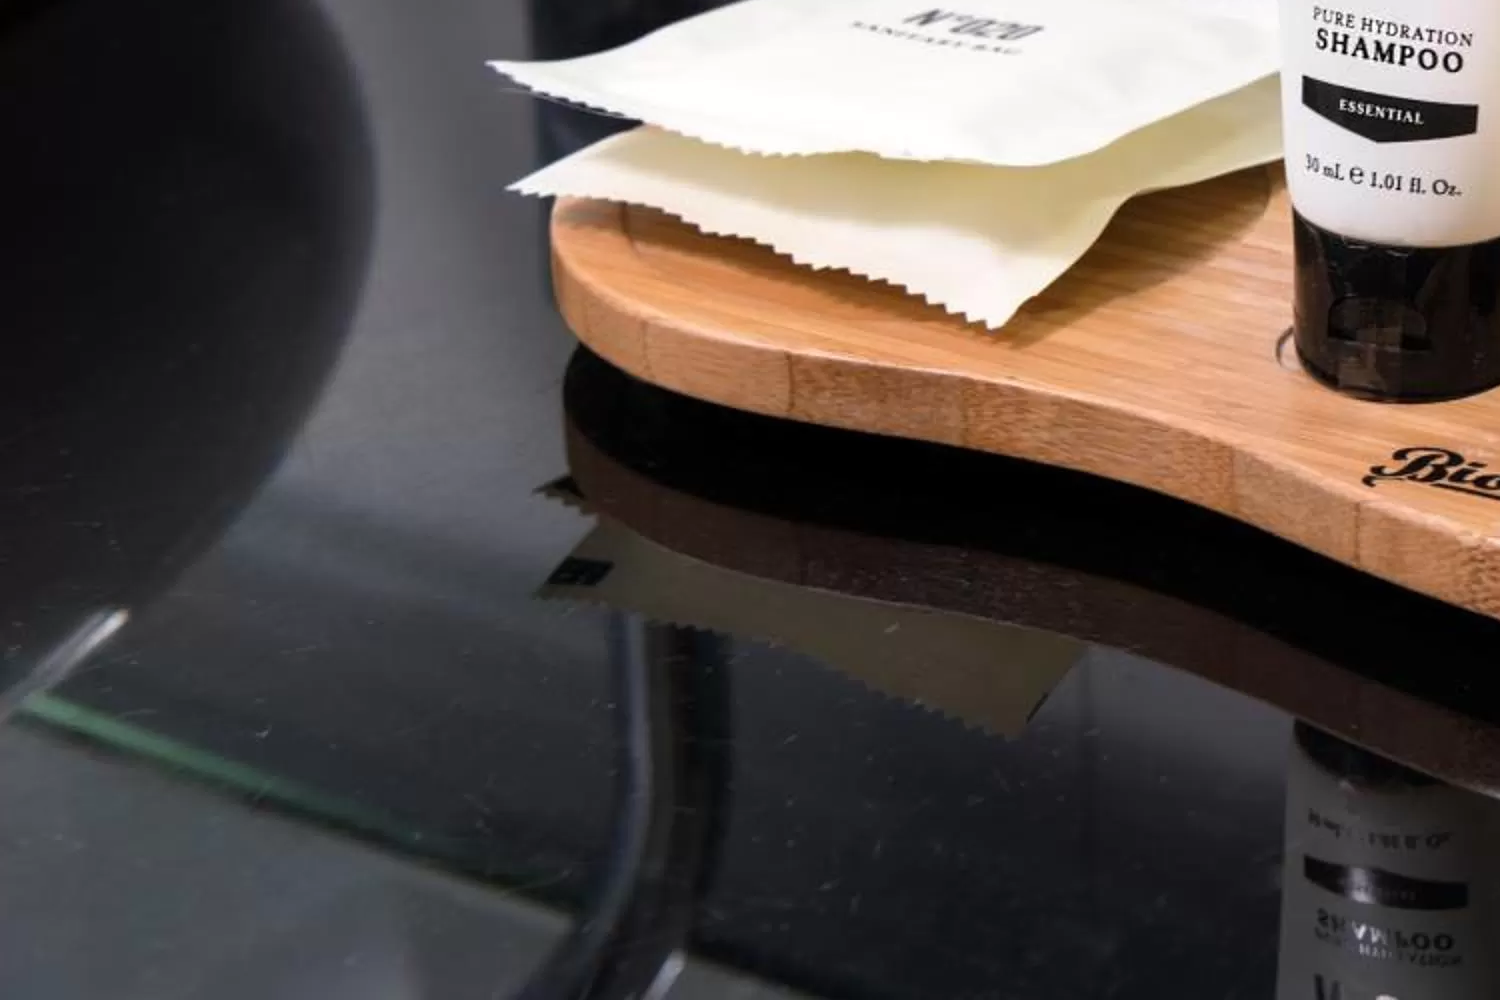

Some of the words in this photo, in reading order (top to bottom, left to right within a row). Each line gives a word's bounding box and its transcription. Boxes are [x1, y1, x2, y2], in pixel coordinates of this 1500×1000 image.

[1313, 6, 1355, 29] PURE
[1361, 16, 1474, 47] HYDRATION
[1315, 28, 1464, 73] SHAMPOO
[1339, 99, 1425, 125] ESSENTIAL
[1370, 171, 1402, 191] 1.01
